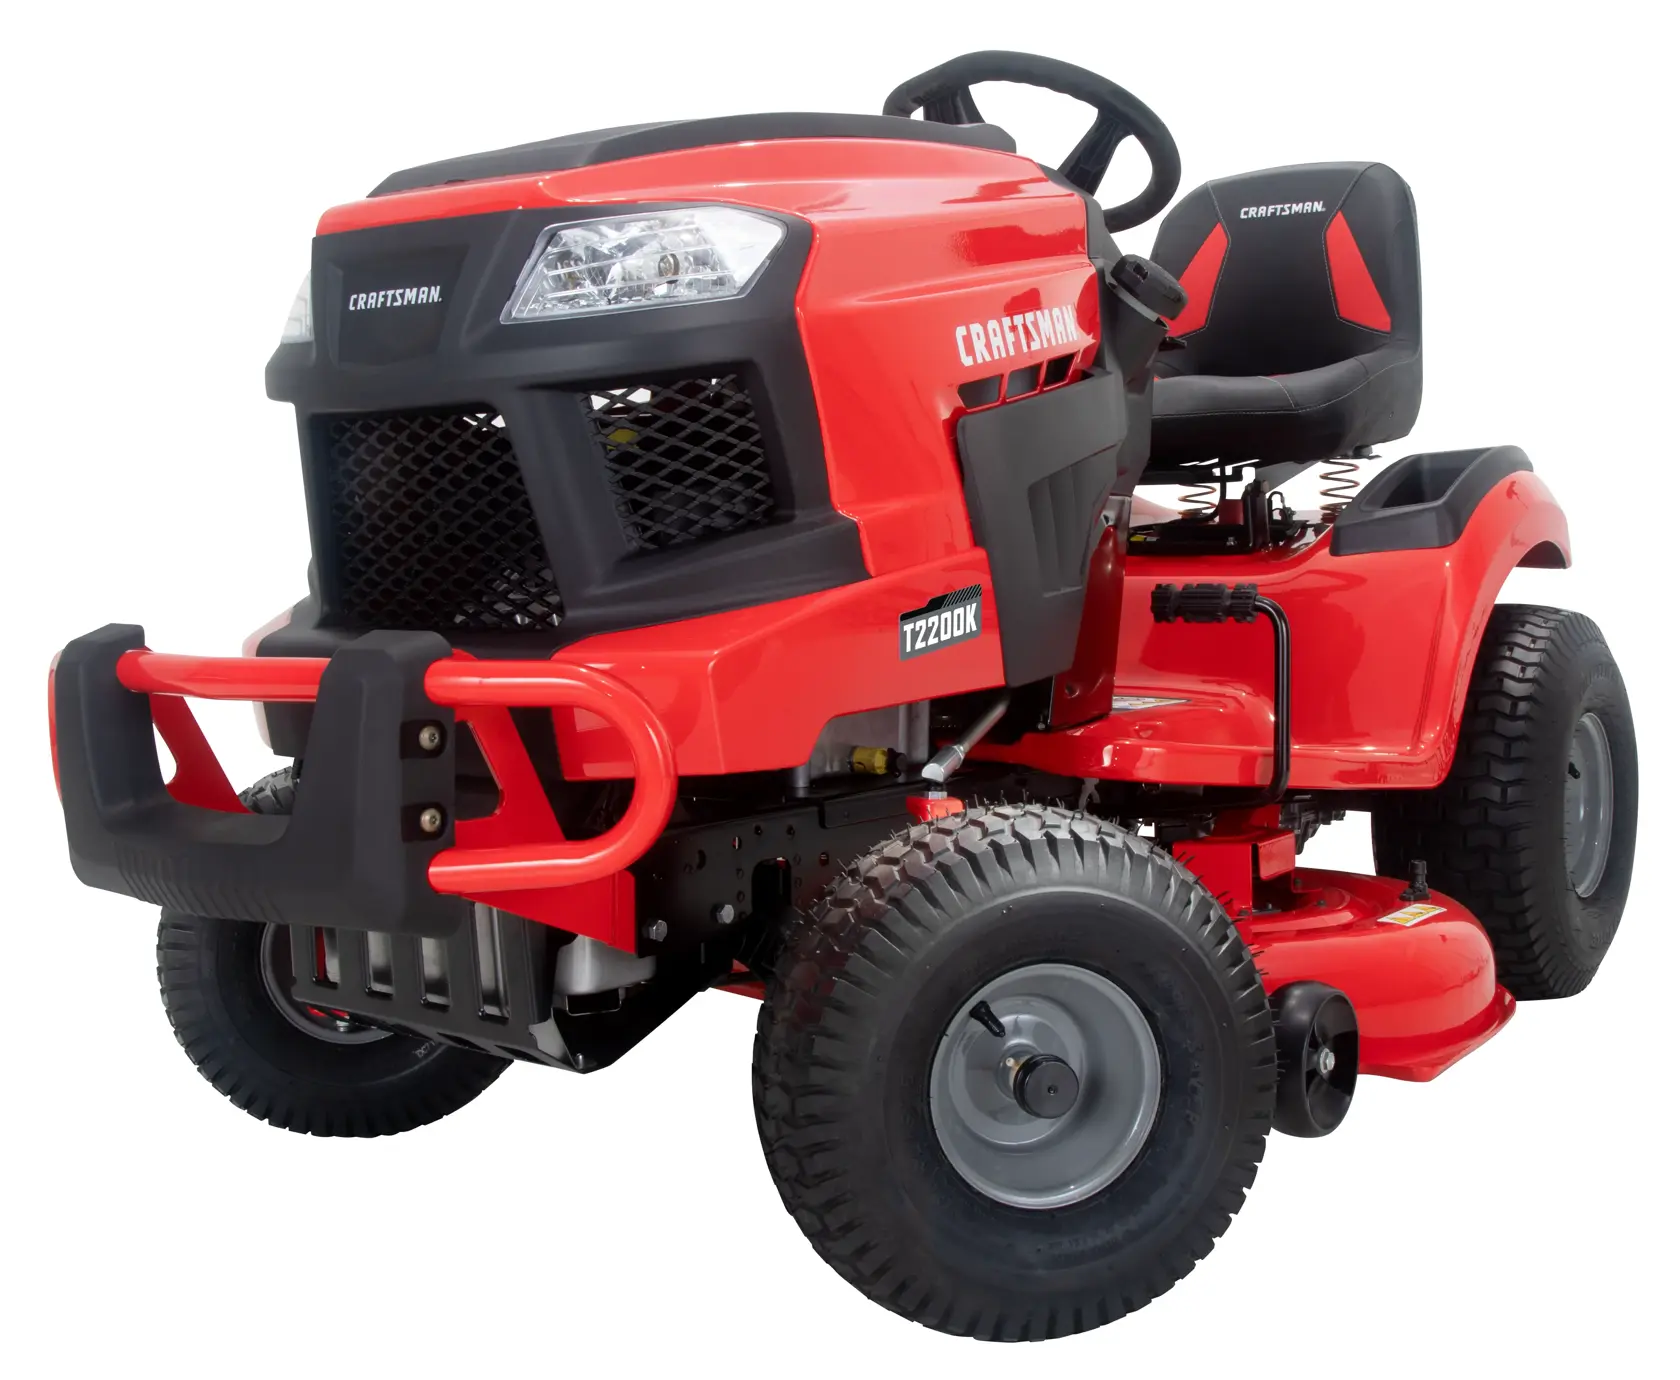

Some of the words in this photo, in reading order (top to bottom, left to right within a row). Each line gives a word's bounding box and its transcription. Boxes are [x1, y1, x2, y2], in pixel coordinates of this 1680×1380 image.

[1239, 200, 1325, 219] CRAFTSMAN
[955, 304, 1078, 367] CRAFTSMAN
[903, 602, 978, 653] T2200K
